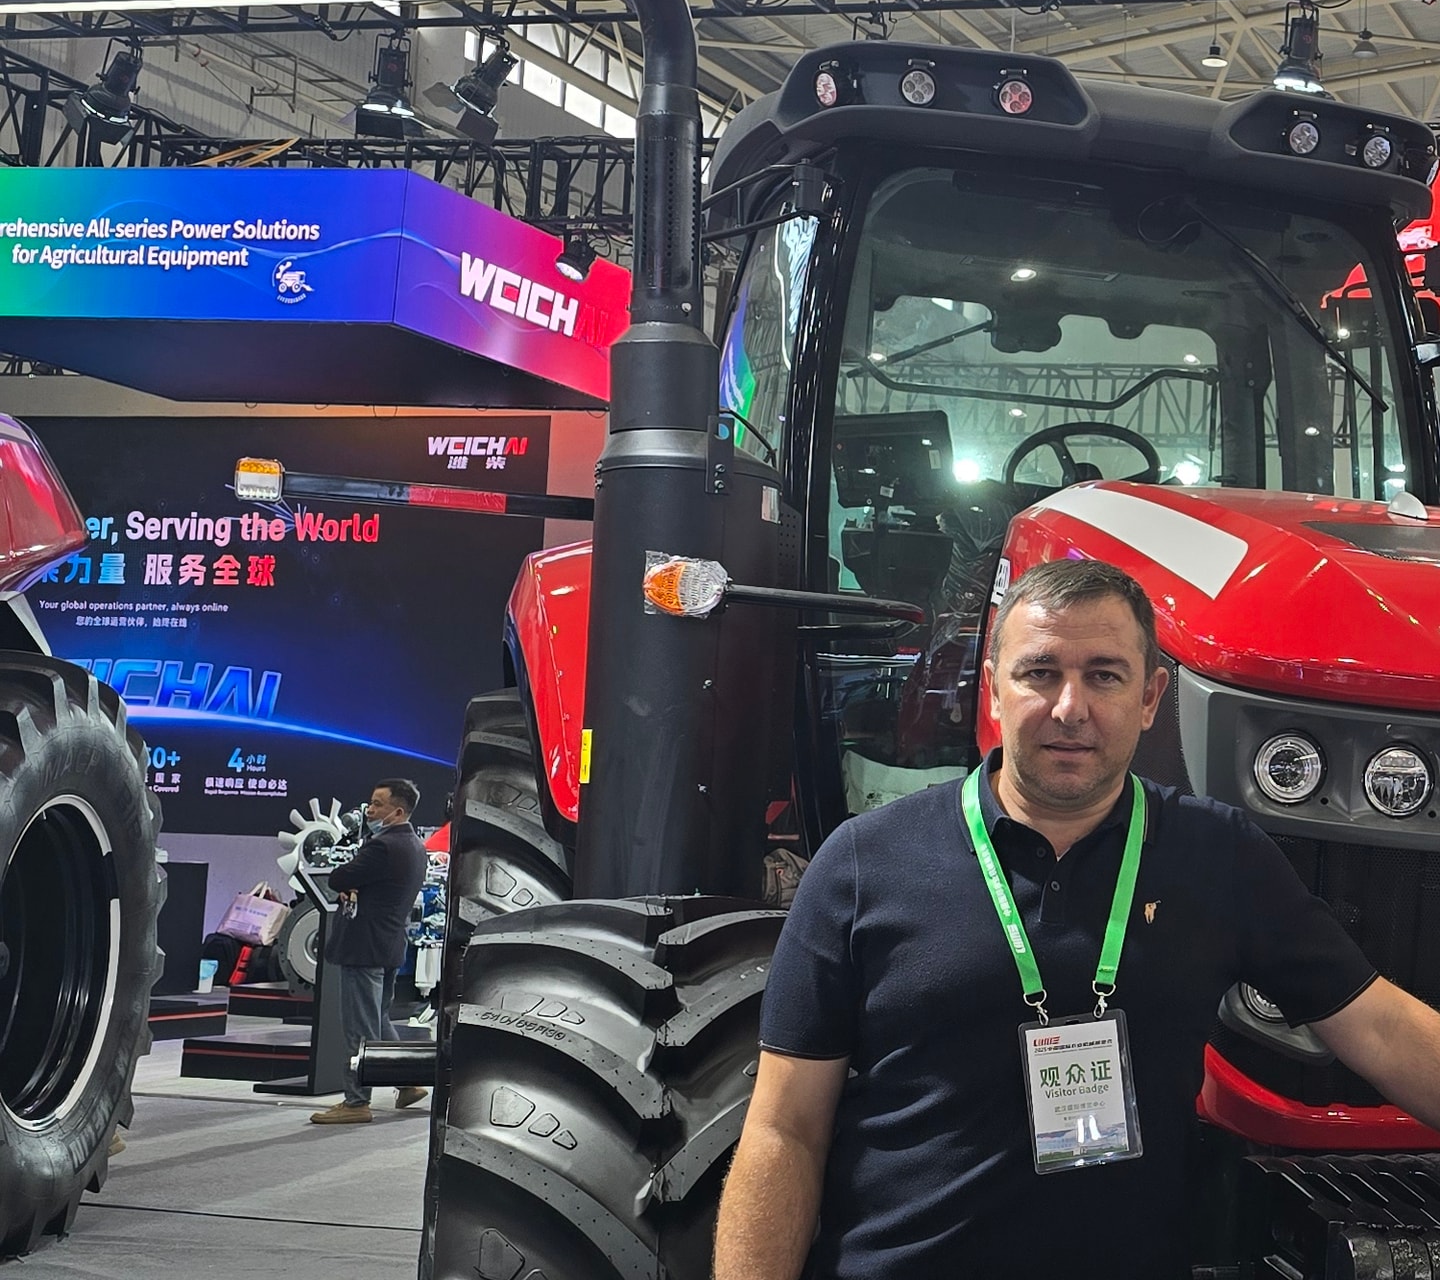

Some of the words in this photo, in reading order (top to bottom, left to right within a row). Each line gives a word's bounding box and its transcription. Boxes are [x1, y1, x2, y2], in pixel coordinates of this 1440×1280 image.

[85, 218, 168, 239] All-series
[170, 220, 231, 240] Power
[232, 219, 320, 241] Solutions
[12, 244, 39, 264] for
[39, 244, 145, 269] Agricultural
[147, 245, 249, 270] Equipment
[427, 436, 529, 456] WEICHAI
[125, 511, 232, 548] Serving
[240, 513, 286, 542] the
[294, 512, 381, 543] World
[143, 553, 276, 587] 服务全球
[39, 600, 58, 609] Your
[61, 600, 87, 611] global
[88, 601, 133, 612] operations
[135, 602, 169, 613] partner,
[171, 602, 201, 613] always
[201, 604, 229, 613] online
[227, 747, 245, 773] 4
[1039, 1059, 1113, 1088] 观众证
[1045, 1087, 1077, 1099] Visitor
[1078, 1083, 1109, 1095] Badge
